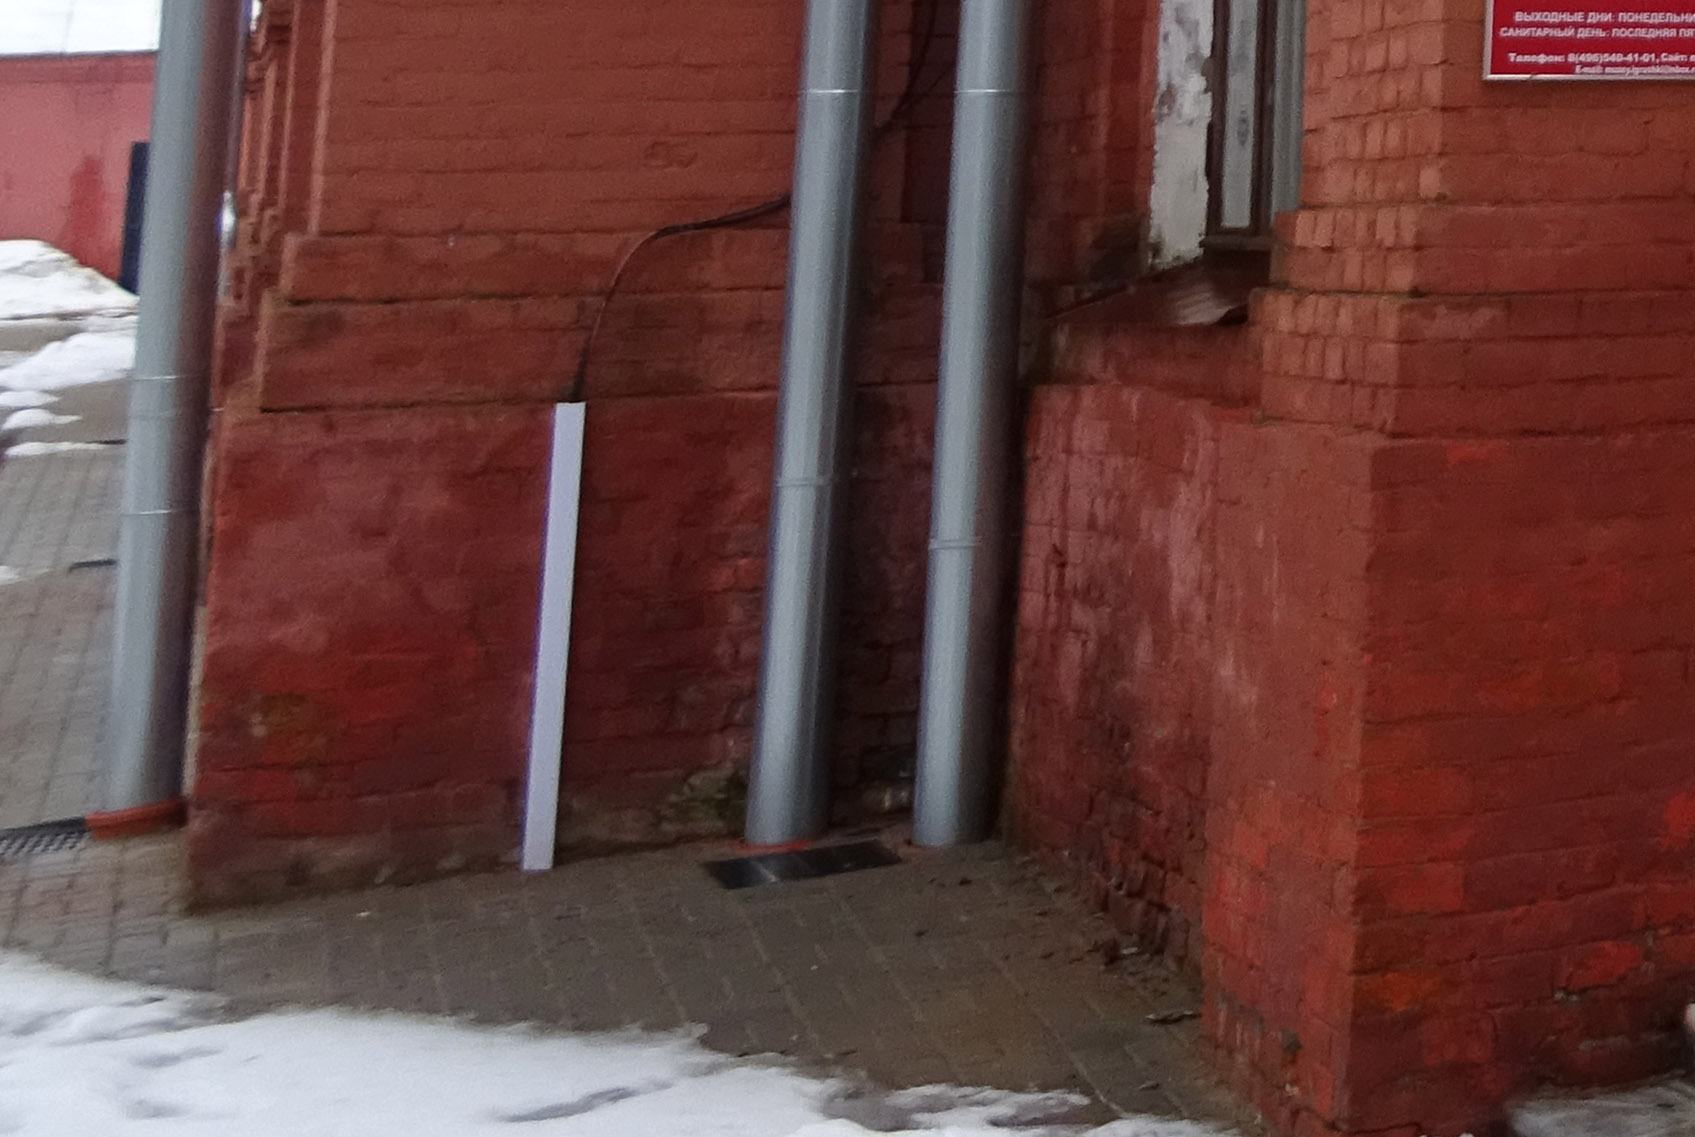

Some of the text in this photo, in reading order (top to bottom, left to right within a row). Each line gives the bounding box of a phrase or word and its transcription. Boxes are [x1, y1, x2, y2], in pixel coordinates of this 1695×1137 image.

[1514, 11, 1585, 23] ВЫХОДНЫЕ
[1586, 12, 1615, 24] ДНИ:
[1499, 26, 1575, 37] САНИТАРНЫЙ
[1576, 27, 1610, 39] ДЕНЬ:
[1611, 28, 1677, 39] ПОСЛЕДНЯЯ
[1508, 52, 1565, 65] Телефон:
